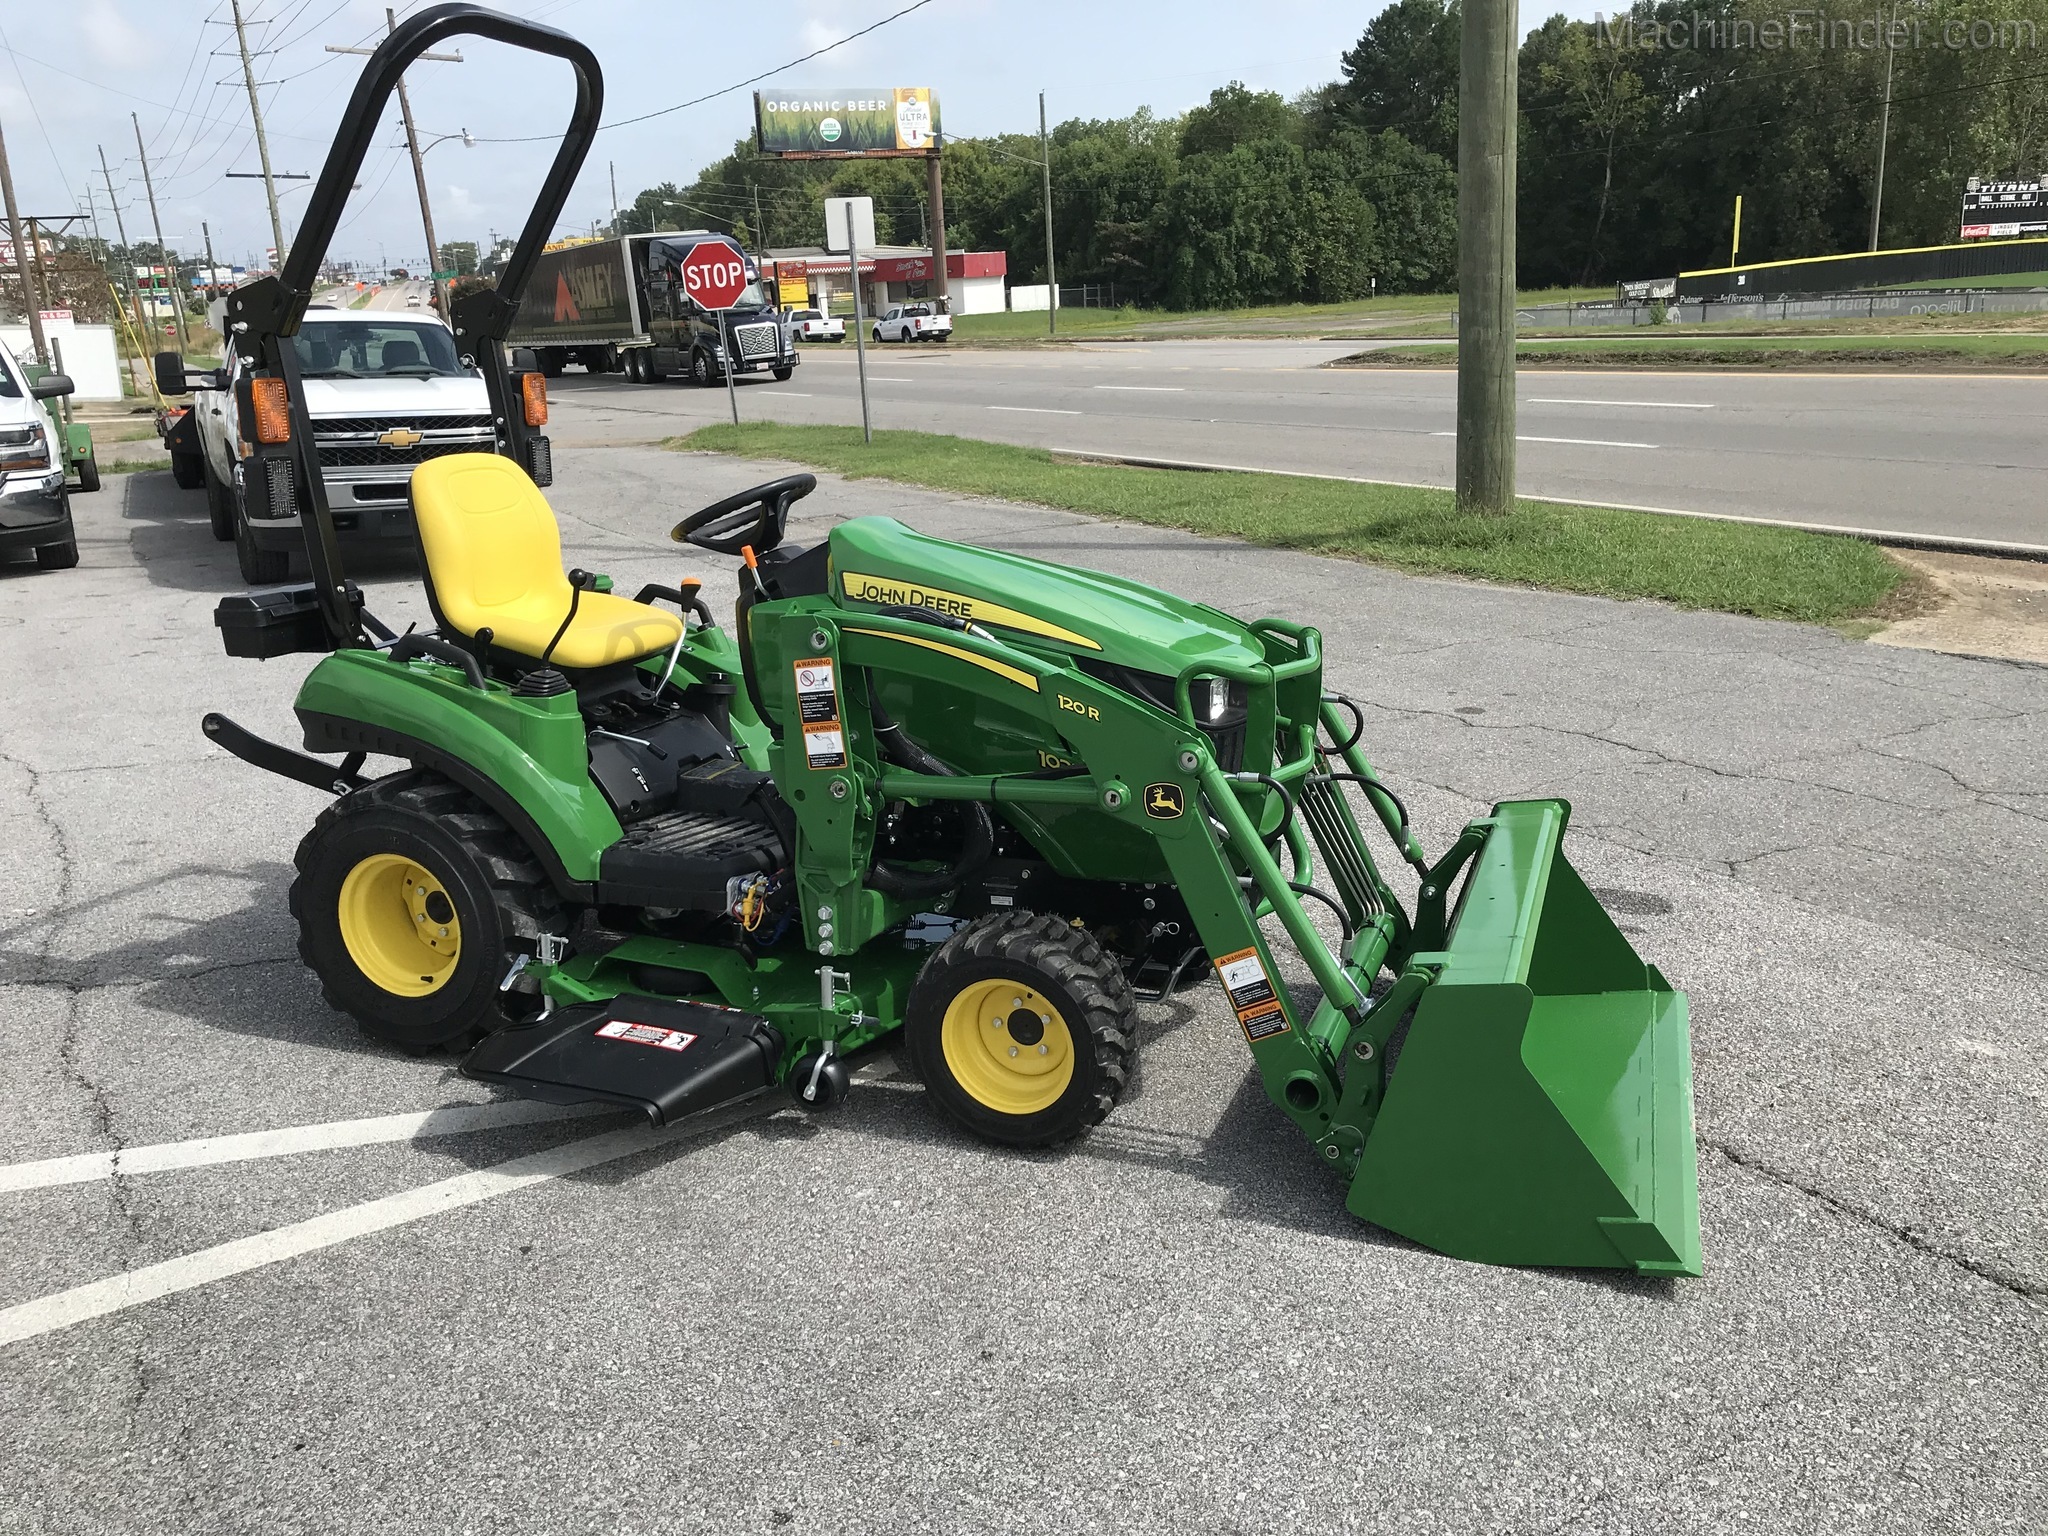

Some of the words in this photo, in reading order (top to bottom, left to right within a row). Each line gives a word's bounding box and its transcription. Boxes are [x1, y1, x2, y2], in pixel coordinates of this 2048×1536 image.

[766, 100, 840, 113] ORGANIC
[847, 100, 887, 112] BEER
[899, 112, 928, 122] ULTRA
[1980, 184, 2039, 192] TITANS
[686, 261, 742, 291] STOP
[1720, 292, 1764, 304] Jefferson's
[855, 581, 906, 605] JOHN
[909, 589, 973, 618] DEERE
[801, 659, 830, 667] WARNING
[1057, 694, 1086, 716] 120
[1086, 705, 1101, 722] R
[810, 724, 839, 732] WARNING
[1226, 950, 1252, 963] WARNING
[1249, 1004, 1277, 1016] WARNING
